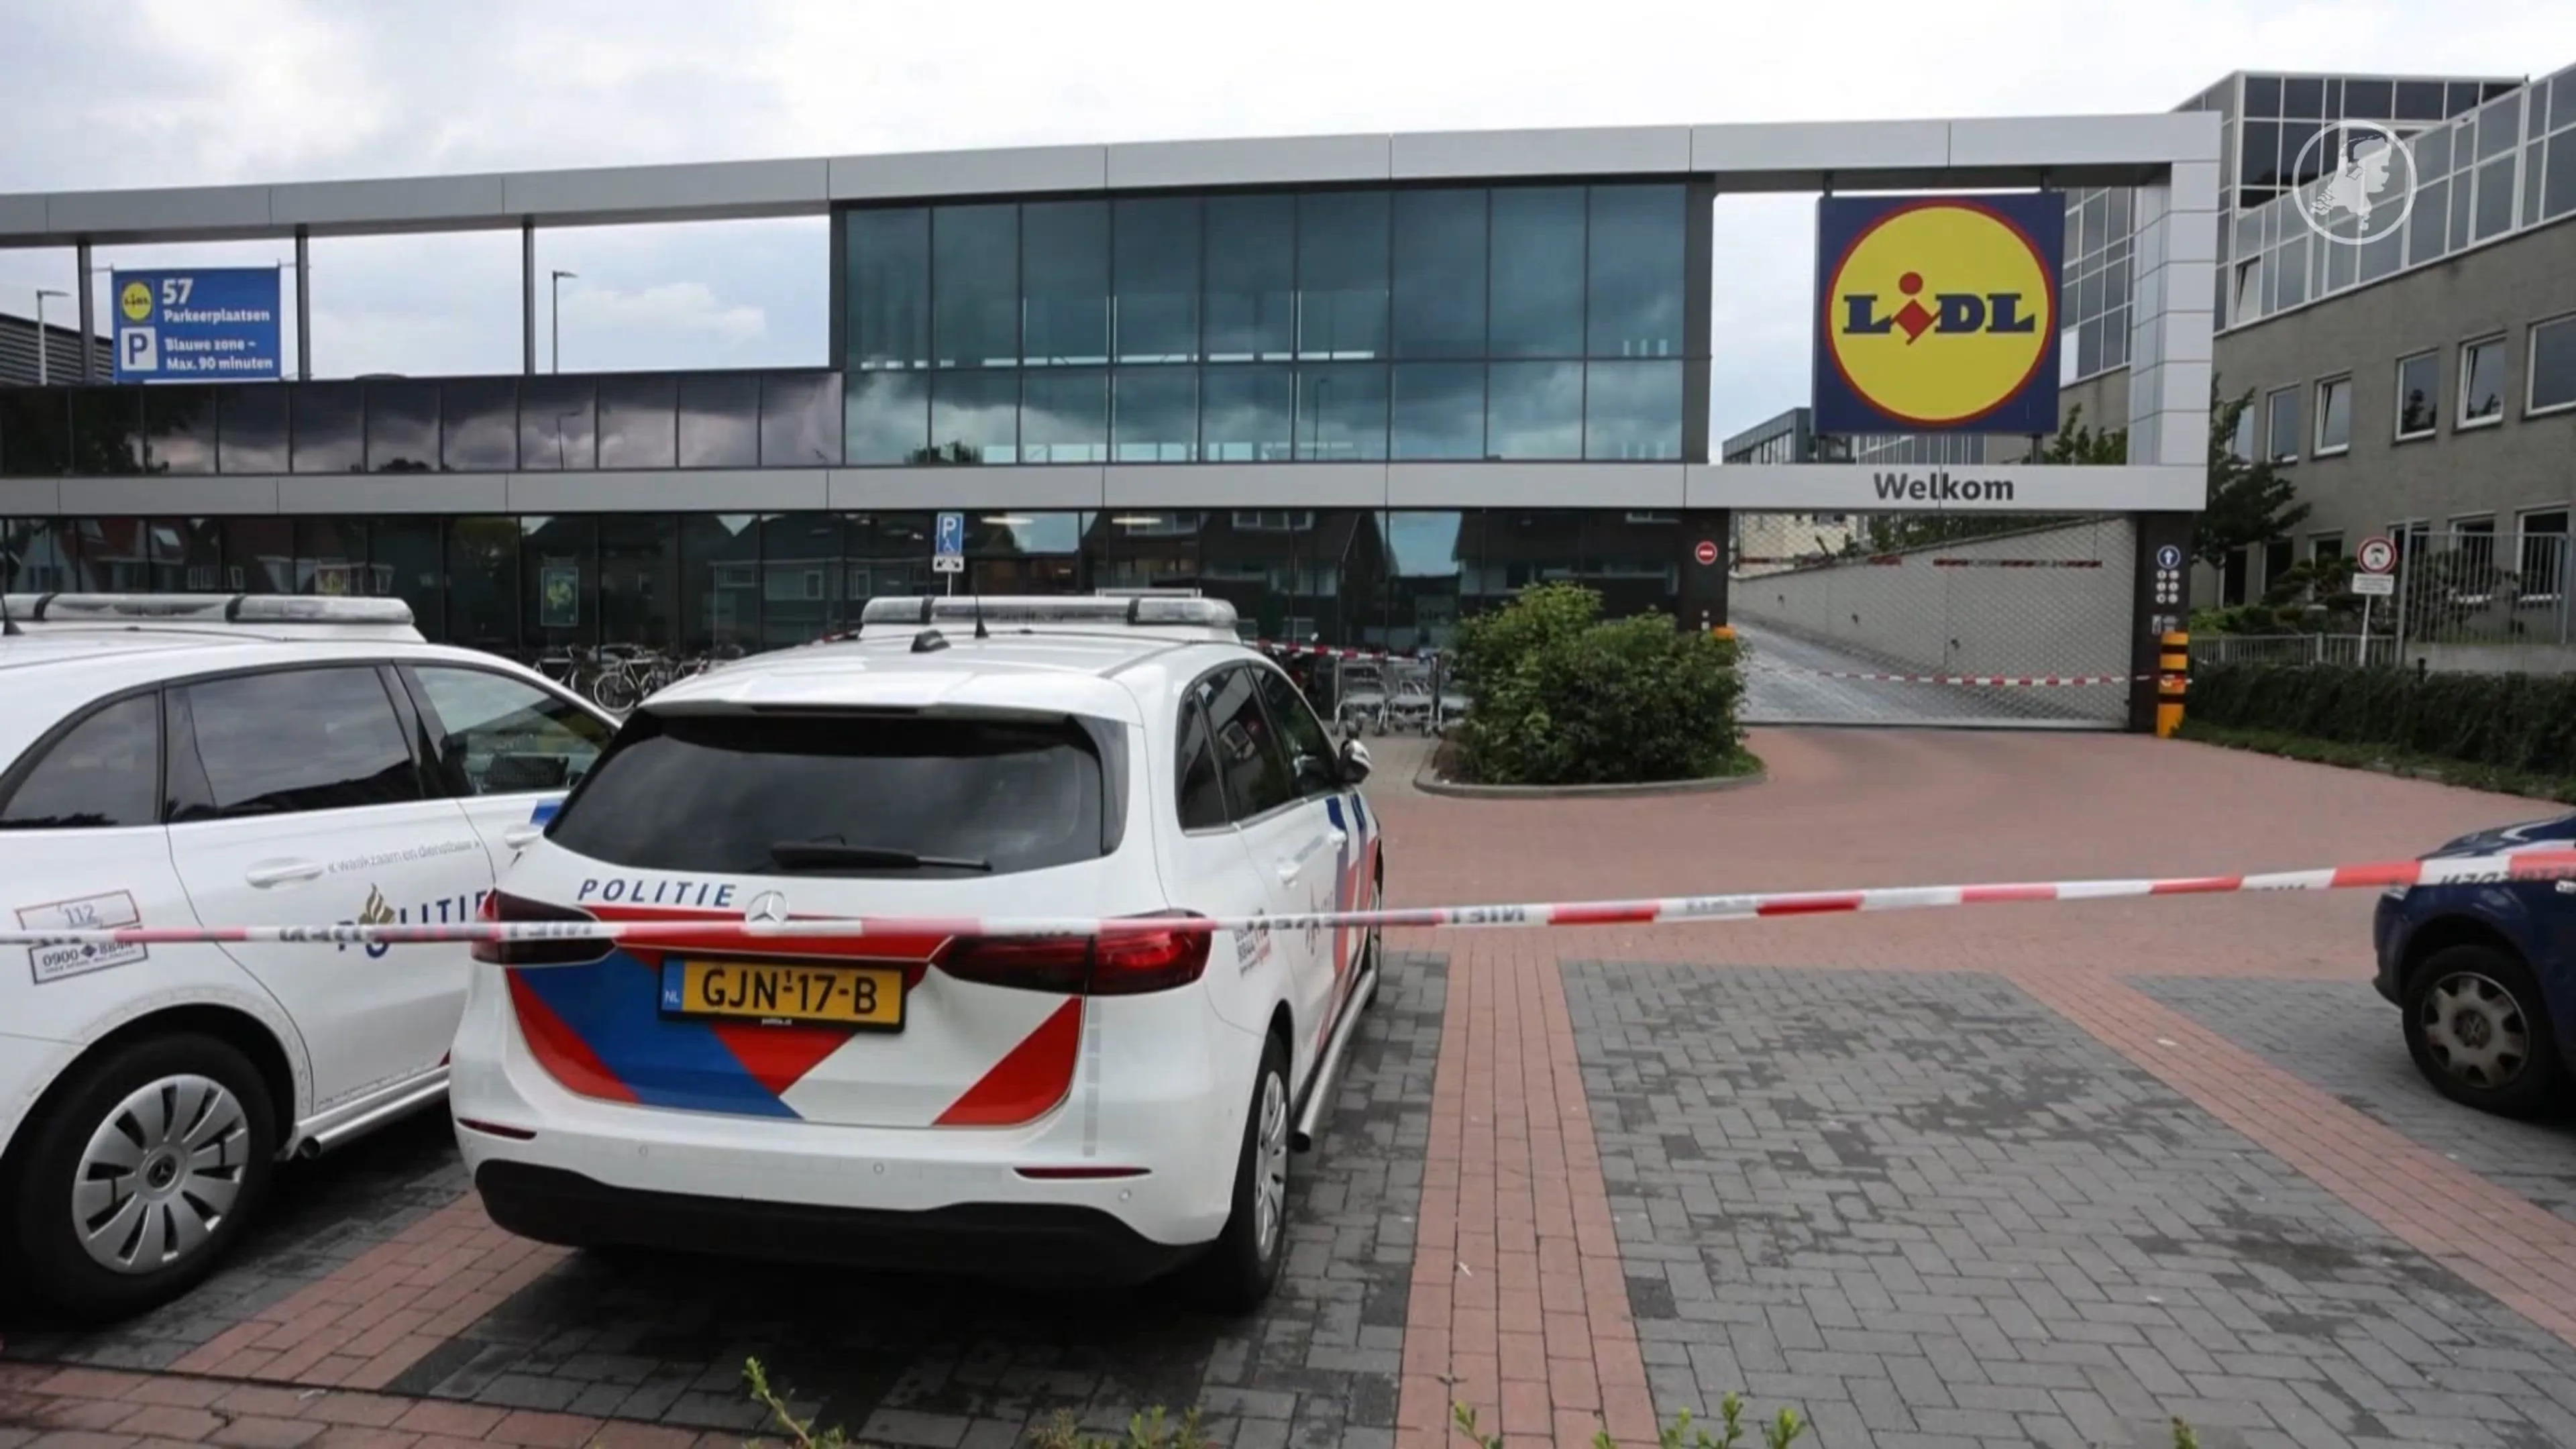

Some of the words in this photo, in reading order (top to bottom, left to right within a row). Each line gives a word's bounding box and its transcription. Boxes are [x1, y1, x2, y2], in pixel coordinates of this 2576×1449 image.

[162, 278, 193, 305] 57
[164, 308, 270, 325] Parkeerplaatsen
[1843, 272, 2035, 345] LIDL
[128, 333, 148, 365] P
[165, 338, 211, 351] Blauwe
[215, 340, 245, 350] zone
[166, 358, 197, 369] Max.
[199, 358, 216, 369] 90
[219, 357, 273, 370] minuten
[1874, 472, 2014, 500] Welkom
[943, 517, 956, 538] P
[578, 879, 737, 908] POLITIE
[64, 904, 100, 925] 112
[42, 949, 78, 967] 0900
[663, 991, 680, 1003] NL
[702, 969, 877, 1014] GJN-17-B
